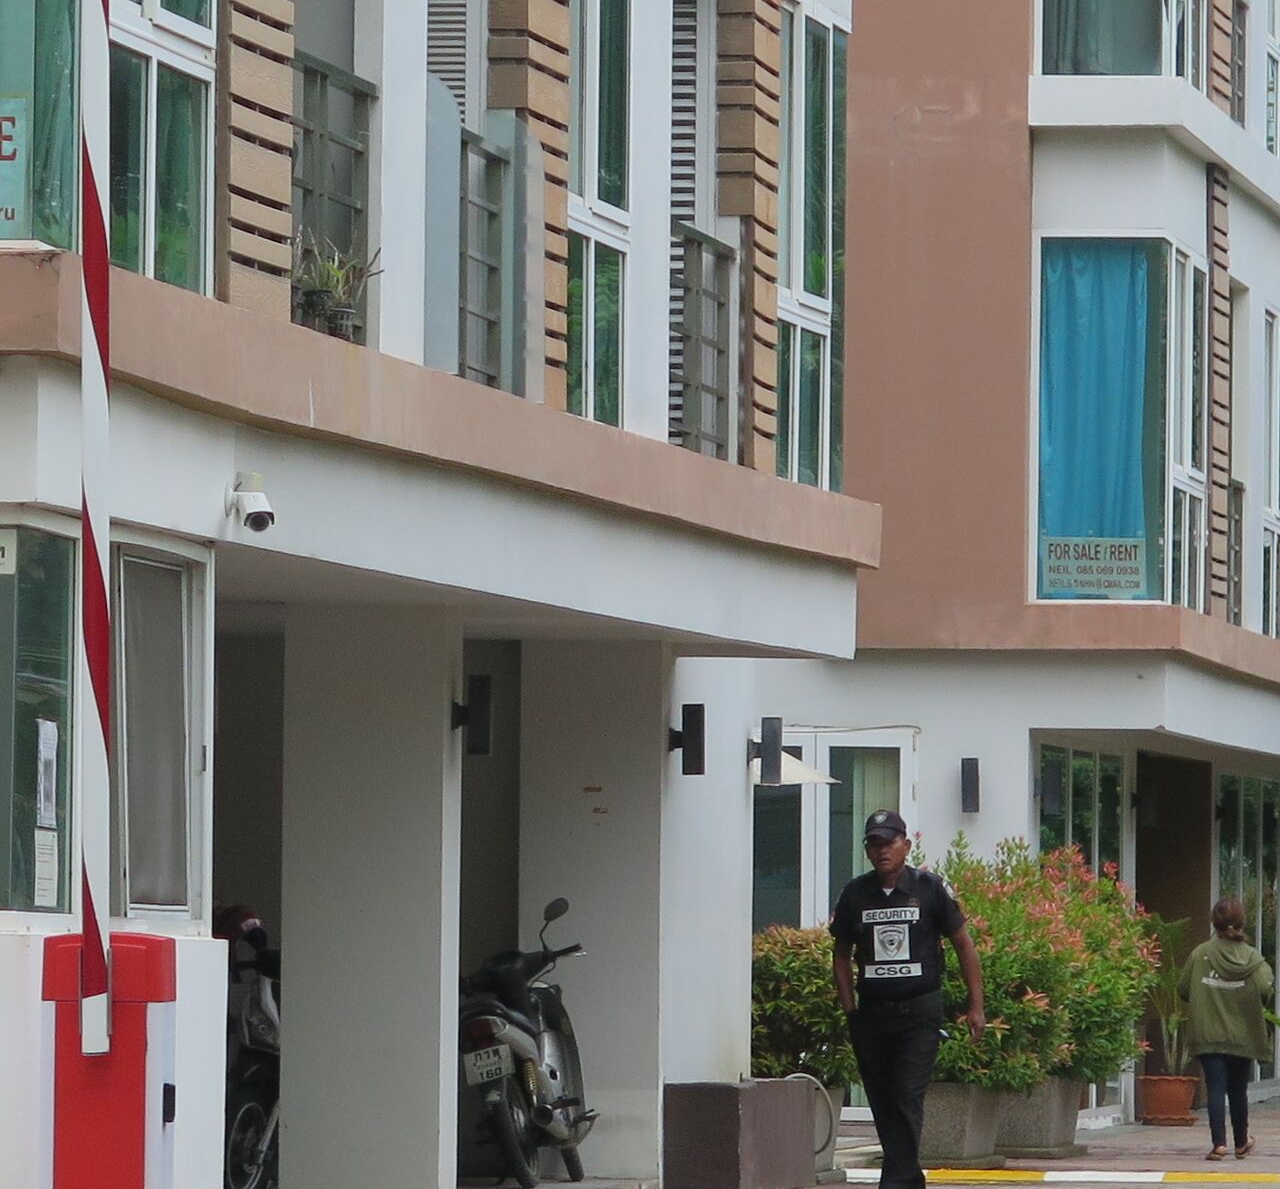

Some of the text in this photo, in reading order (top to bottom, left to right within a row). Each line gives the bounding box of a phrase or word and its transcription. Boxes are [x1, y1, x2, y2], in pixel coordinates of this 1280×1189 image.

[1048, 544, 1071, 560] FOR
[1074, 544, 1100, 560] SALE
[1110, 544, 1138, 561] RENT
[1049, 565, 1071, 574] NEIL
[865, 909, 916, 921] SECURITY
[875, 966, 912, 976] CSG
[480, 1067, 502, 1081] 160
